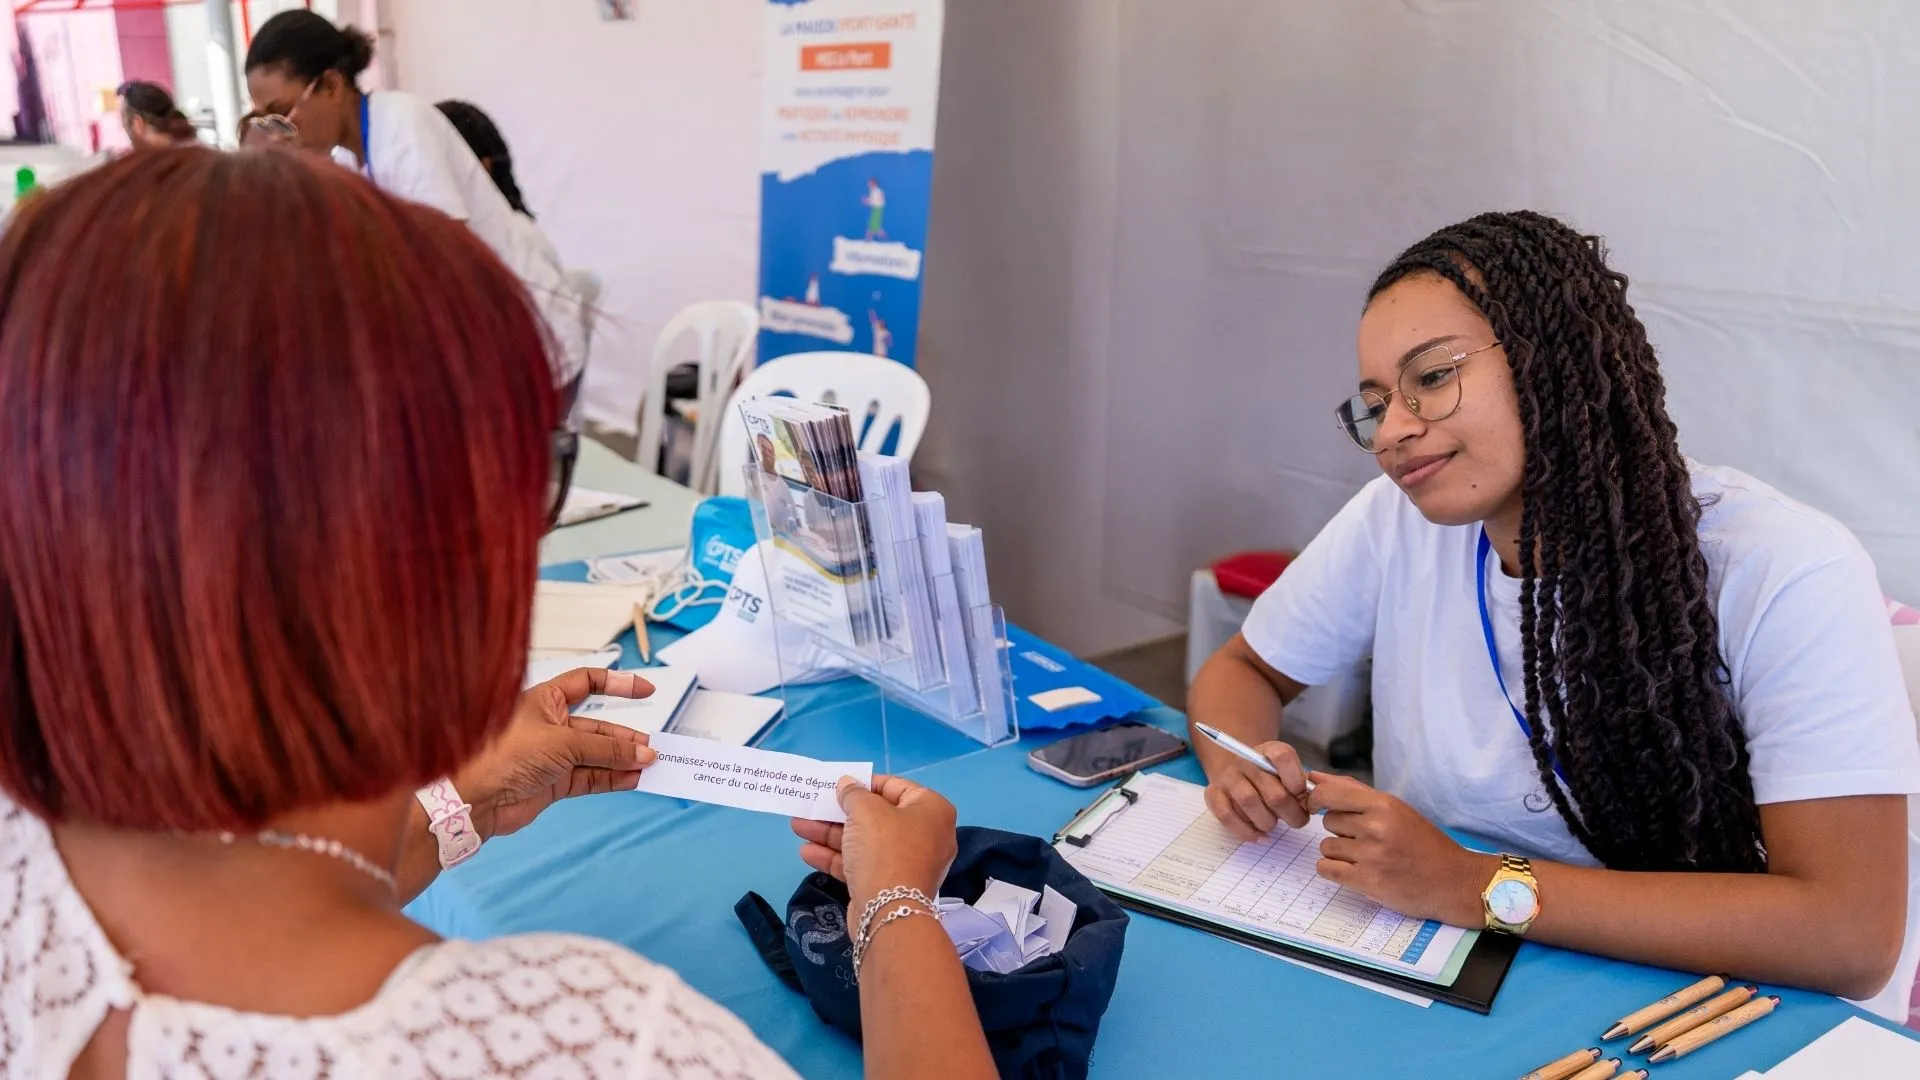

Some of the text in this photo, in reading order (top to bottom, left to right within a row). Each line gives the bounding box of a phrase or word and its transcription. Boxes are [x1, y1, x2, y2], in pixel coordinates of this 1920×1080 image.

[693, 772, 727, 785] cancer
[727, 777, 741, 788] du
[743, 781, 758, 792] col
[759, 783, 772, 793] de
[774, 784, 811, 800] l'utérus
[732, 763, 742, 773] la
[743, 767, 788, 781] méthode
[789, 773, 803, 784] de
[805, 776, 838, 790] dépist
